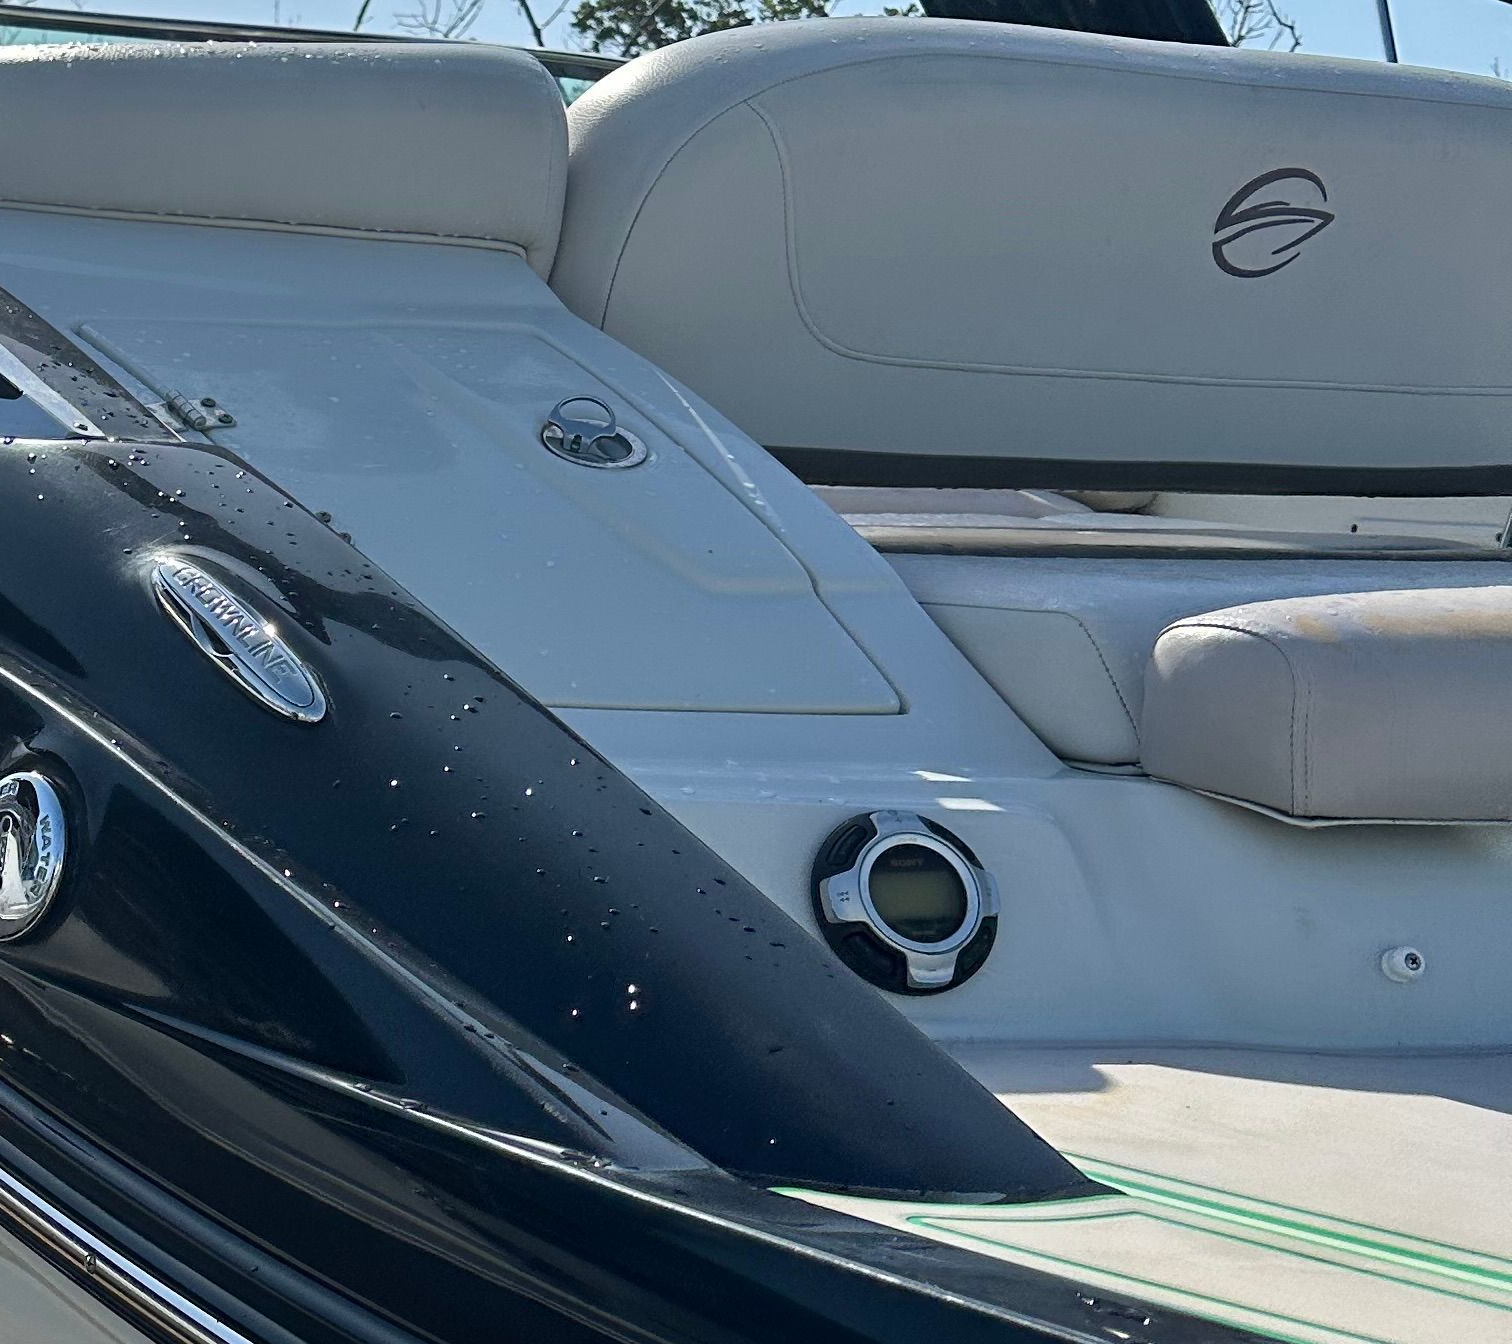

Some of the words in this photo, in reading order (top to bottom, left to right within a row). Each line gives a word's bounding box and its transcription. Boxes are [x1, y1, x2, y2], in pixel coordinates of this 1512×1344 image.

[171, 566, 298, 685] CROWNLINE
[25, 813, 53, 900] WATER
[890, 858, 924, 868] SONY
